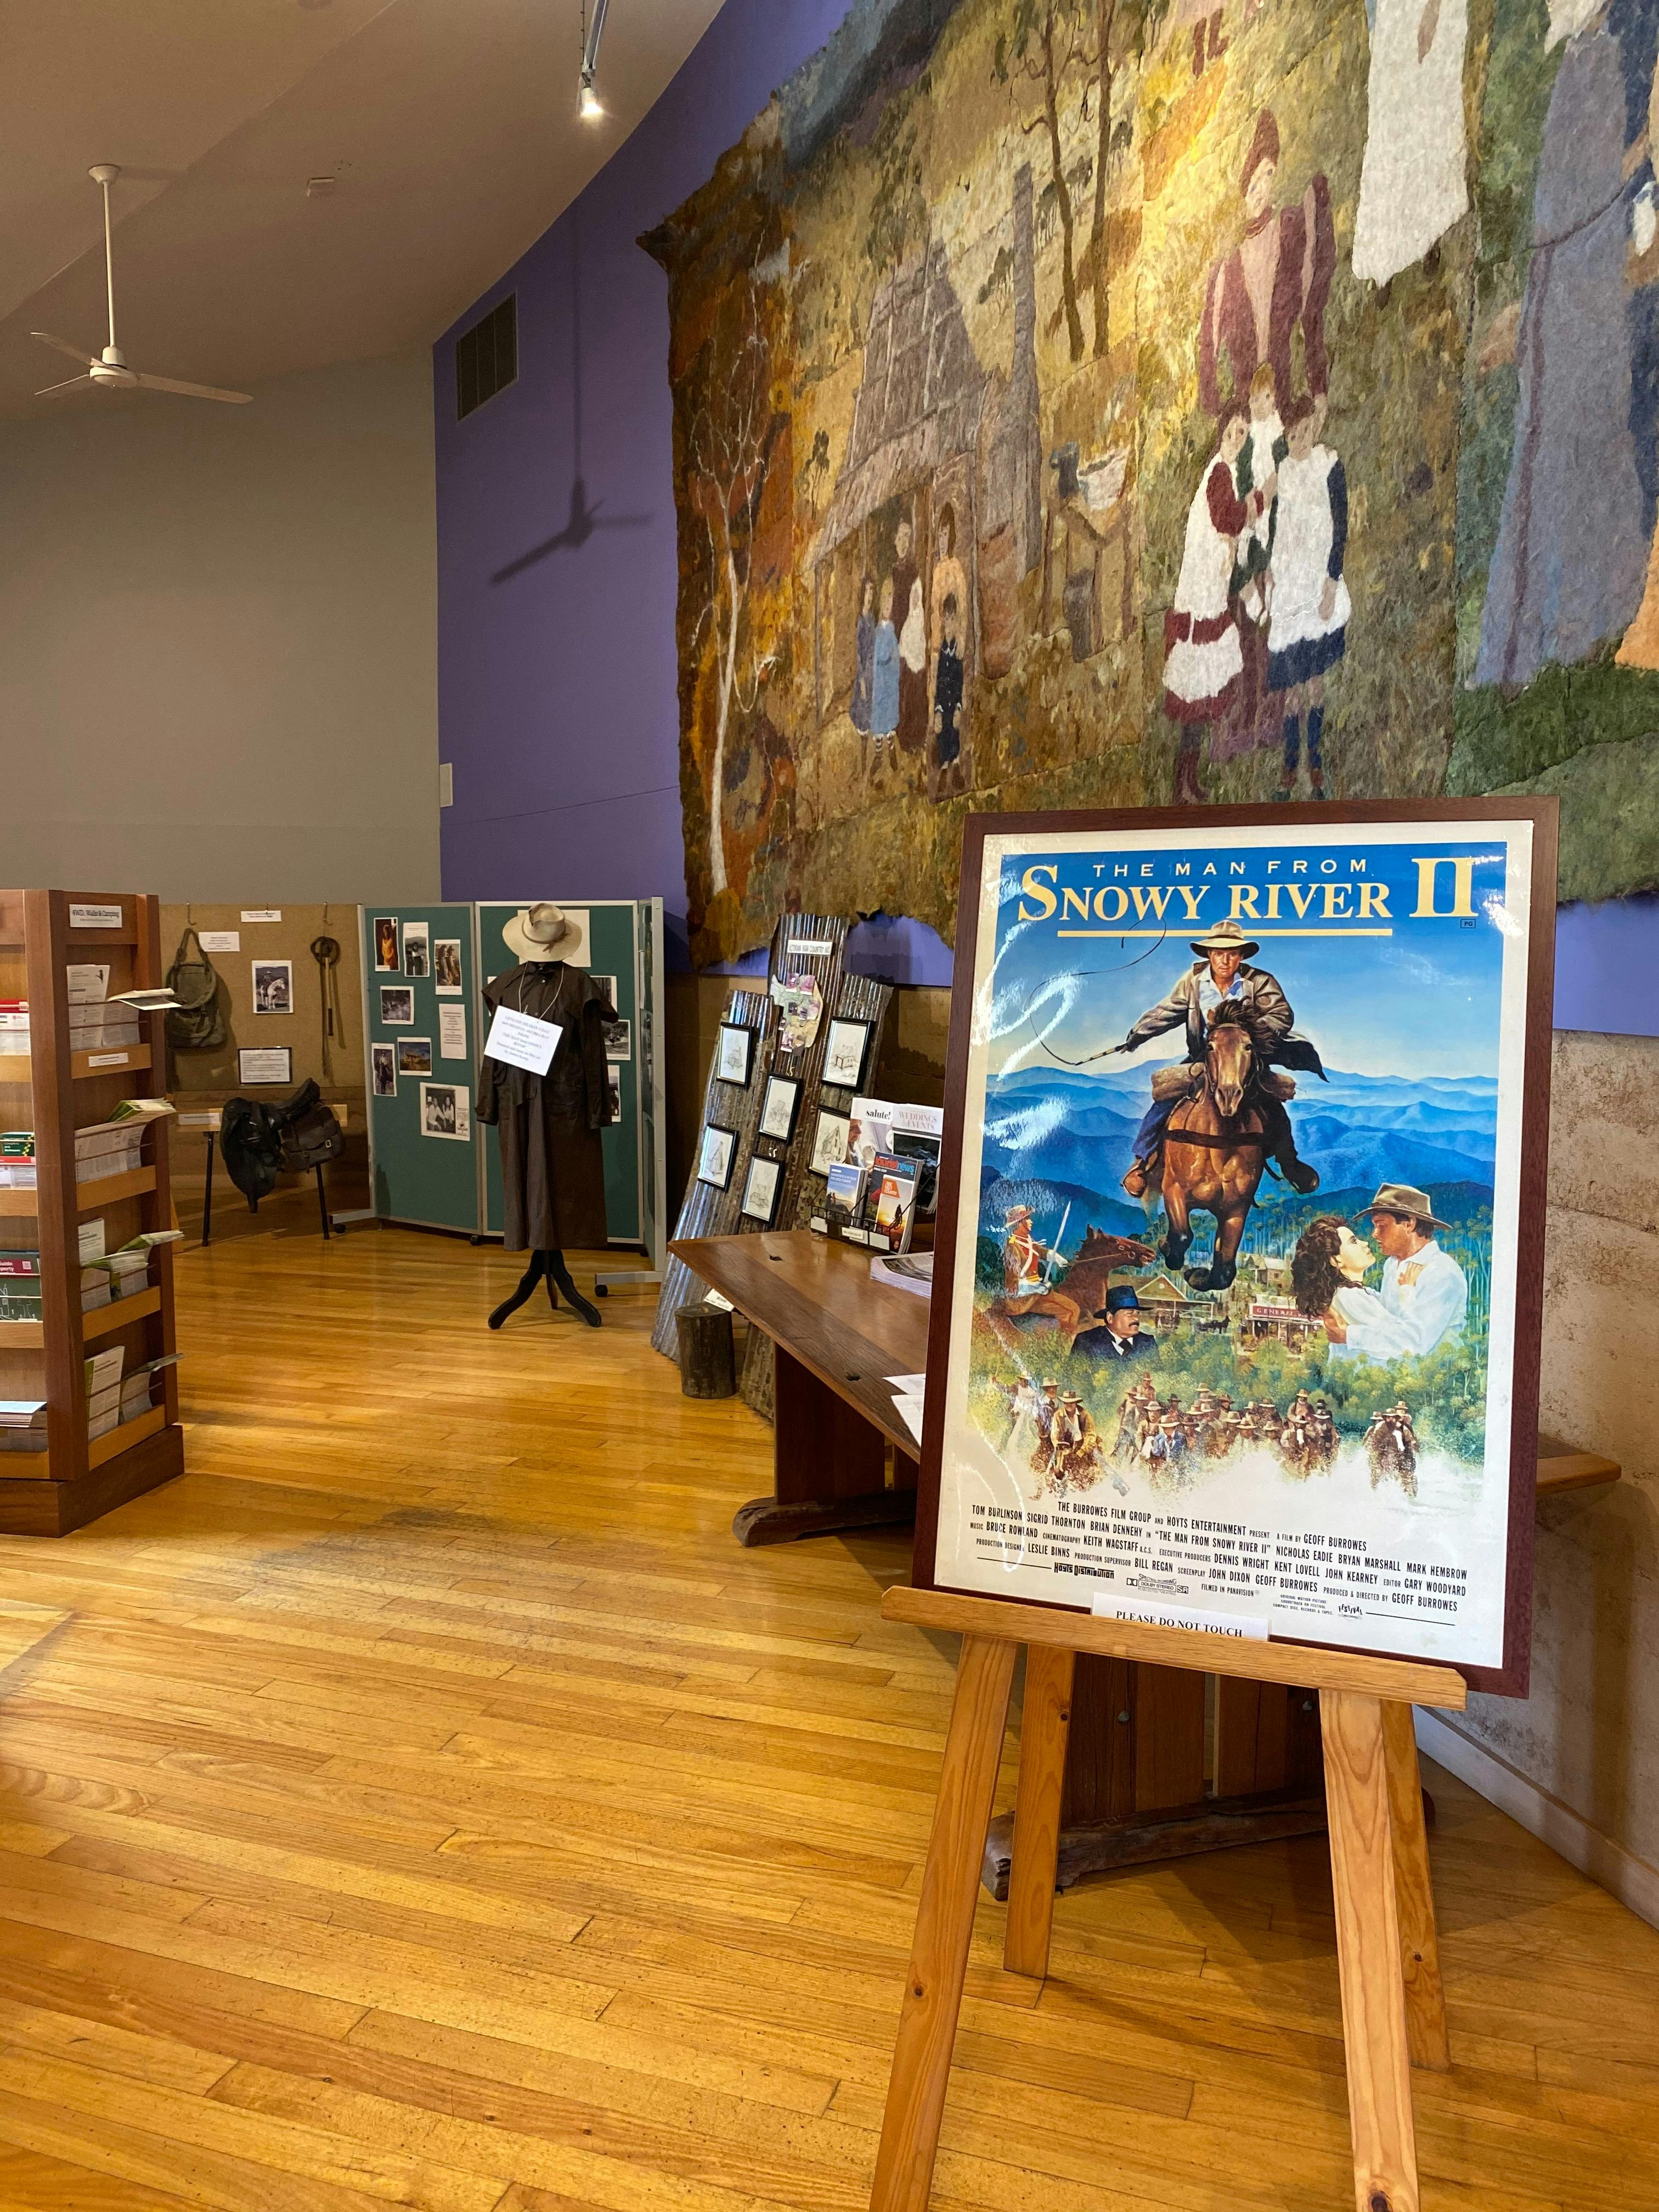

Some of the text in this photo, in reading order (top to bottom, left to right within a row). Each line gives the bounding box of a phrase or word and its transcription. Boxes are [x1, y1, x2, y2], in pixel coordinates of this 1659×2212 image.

[1093, 859, 1368, 878] THE MAN FROM
[1019, 857, 1479, 922] SNOWY RIVER II
[866, 1109, 890, 1120] salute!
[1256, 1307, 1294, 1317] GENERAL
[1058, 1502, 1069, 1513] THE
[1074, 1503, 1107, 1517] BURROWES
[1111, 1508, 1125, 1520] FILM
[1130, 1511, 1151, 1523] GROUP
[1167, 1516, 1188, 1528] HOYTS
[1192, 1519, 1246, 1536] ENTERTAINMENT
[1250, 1530, 1269, 1539] PRESENT
[1304, 1533, 1325, 1546] GEOFF
[1329, 1537, 1367, 1551] BURROWES
[972, 1505, 985, 1516] TOM
[989, 1507, 1022, 1521] BURLINSON
[1028, 1513, 1048, 1525] SIGRID
[1052, 1516, 1085, 1530] THORNTON
[1091, 1521, 1109, 1533] BRIAN
[1113, 1524, 1142, 1537] DENNEHY
[1175, 1533, 1188, 1544] MAN
[1192, 1535, 1209, 1547] FROM
[1212, 1538, 1235, 1550] SNOWY
[1239, 1541, 1257, 1553] RIVER
[1276, 1546, 1309, 1560] NICHOLAS
[1313, 1550, 1333, 1563] EADIE
[1339, 1554, 1361, 1566] BRYAN
[1365, 1557, 1401, 1571] MARSHALL
[1407, 1562, 1426, 1575] MARK
[1431, 1566, 1467, 1580] HEMBROW
[970, 1522, 983, 1530] MUSIC
[986, 1521, 1006, 1533] BRUCE
[1009, 1525, 1037, 1538] ROWLAND
[1043, 1532, 1080, 1544] CINEMATOGRAPHY
[1084, 1536, 1102, 1547] KEITH
[1106, 1538, 1138, 1552] WAGSTAFF
[1160, 1549, 1182, 1558] EXECUTIVE
[1184, 1552, 1211, 1562] PRODUCERS
[1215, 1553, 1238, 1566] DENNIS
[1243, 1557, 1269, 1570] WRIGHT
[1275, 1561, 1291, 1573] KENT
[1296, 1564, 1319, 1577] LOVELL
[1325, 1568, 1342, 1580] JOHN
[1347, 1571, 1378, 1584] KEARNEY
[1384, 1579, 1401, 1588] EDITOR
[1404, 1578, 1422, 1590] GARY
[1426, 1582, 1466, 1596] WOODYARD
[977, 1538, 1002, 1548] PRODUCTION
[1028, 1543, 1048, 1555] LESLIE
[1051, 1547, 1069, 1558] BINNS
[1075, 1553, 1102, 1562] PRODUCTION
[1104, 1556, 1131, 1566] SUPERVISOR
[1135, 1558, 1148, 1569] BILL
[1152, 1560, 1173, 1572] REGAN
[1178, 1567, 1205, 1577] SCREENPLAY
[1209, 1568, 1226, 1580] JOHN
[1230, 1571, 1250, 1583] DIXON
[1256, 1575, 1276, 1587] GEOFF
[1280, 1578, 1317, 1593] BURROWES
[1323, 1587, 1348, 1596] PRODUCED
[1357, 1591, 1379, 1601] DIRECTED
[1392, 1593, 1414, 1606] GEOFF
[1418, 1596, 1457, 1612] BURROWES
[1177, 1585, 1188, 1594] SR
[1201, 1583, 1217, 1592] FILMED
[1227, 1587, 1254, 1597] PANAVISION
[1339, 1604, 1363, 1615] FESTIVAL
[1116, 1611, 1243, 1637] PLEASE DO NOT TOUCH
